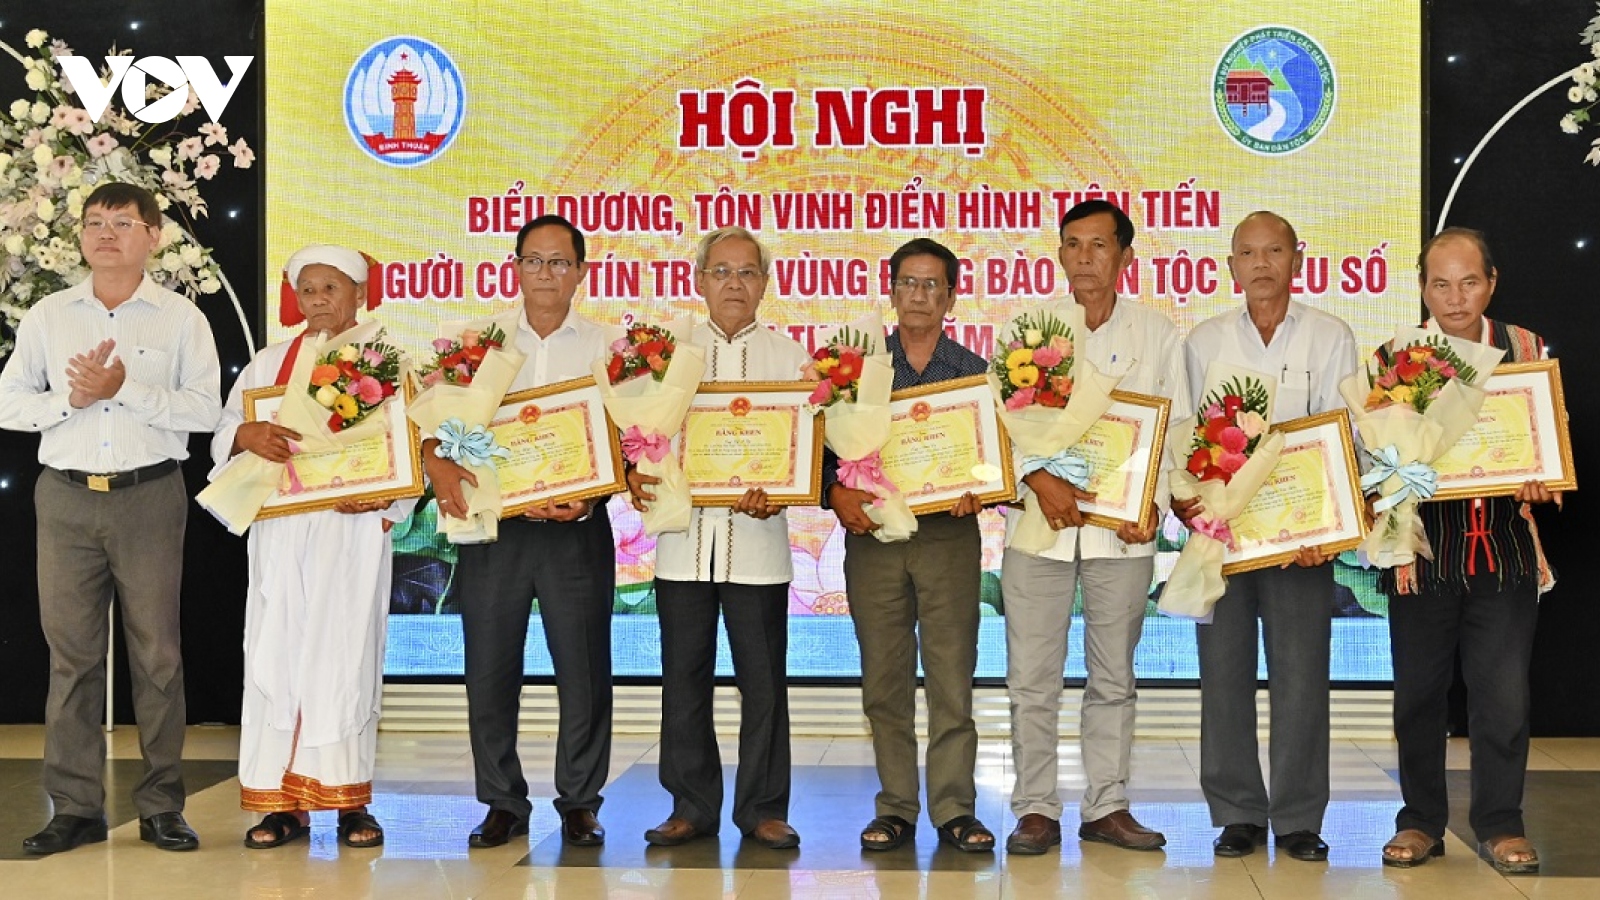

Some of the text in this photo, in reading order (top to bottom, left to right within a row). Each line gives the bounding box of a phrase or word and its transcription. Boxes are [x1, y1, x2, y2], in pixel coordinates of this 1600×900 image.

[679, 79, 985, 158] HỘI NGHỊ
[468, 180, 545, 233] BIỂU
[556, 191, 684, 236] DƯƠNG,
[695, 186, 762, 231] TÔN
[773, 192, 853, 230] VINH
[865, 176, 946, 230] ĐIỂN
[958, 184, 1041, 229] HÌNH
[1142, 178, 1220, 228] TIẾN
[379, 253, 464, 299] GƯỜI
[476, 254, 520, 299] CÓ
[587, 253, 640, 298] TÍN
[776, 252, 868, 297] VÙNG
[987, 250, 1055, 295] BÀO
[1152, 250, 1217, 303] TỘC
[1341, 242, 1388, 294] SỐ
